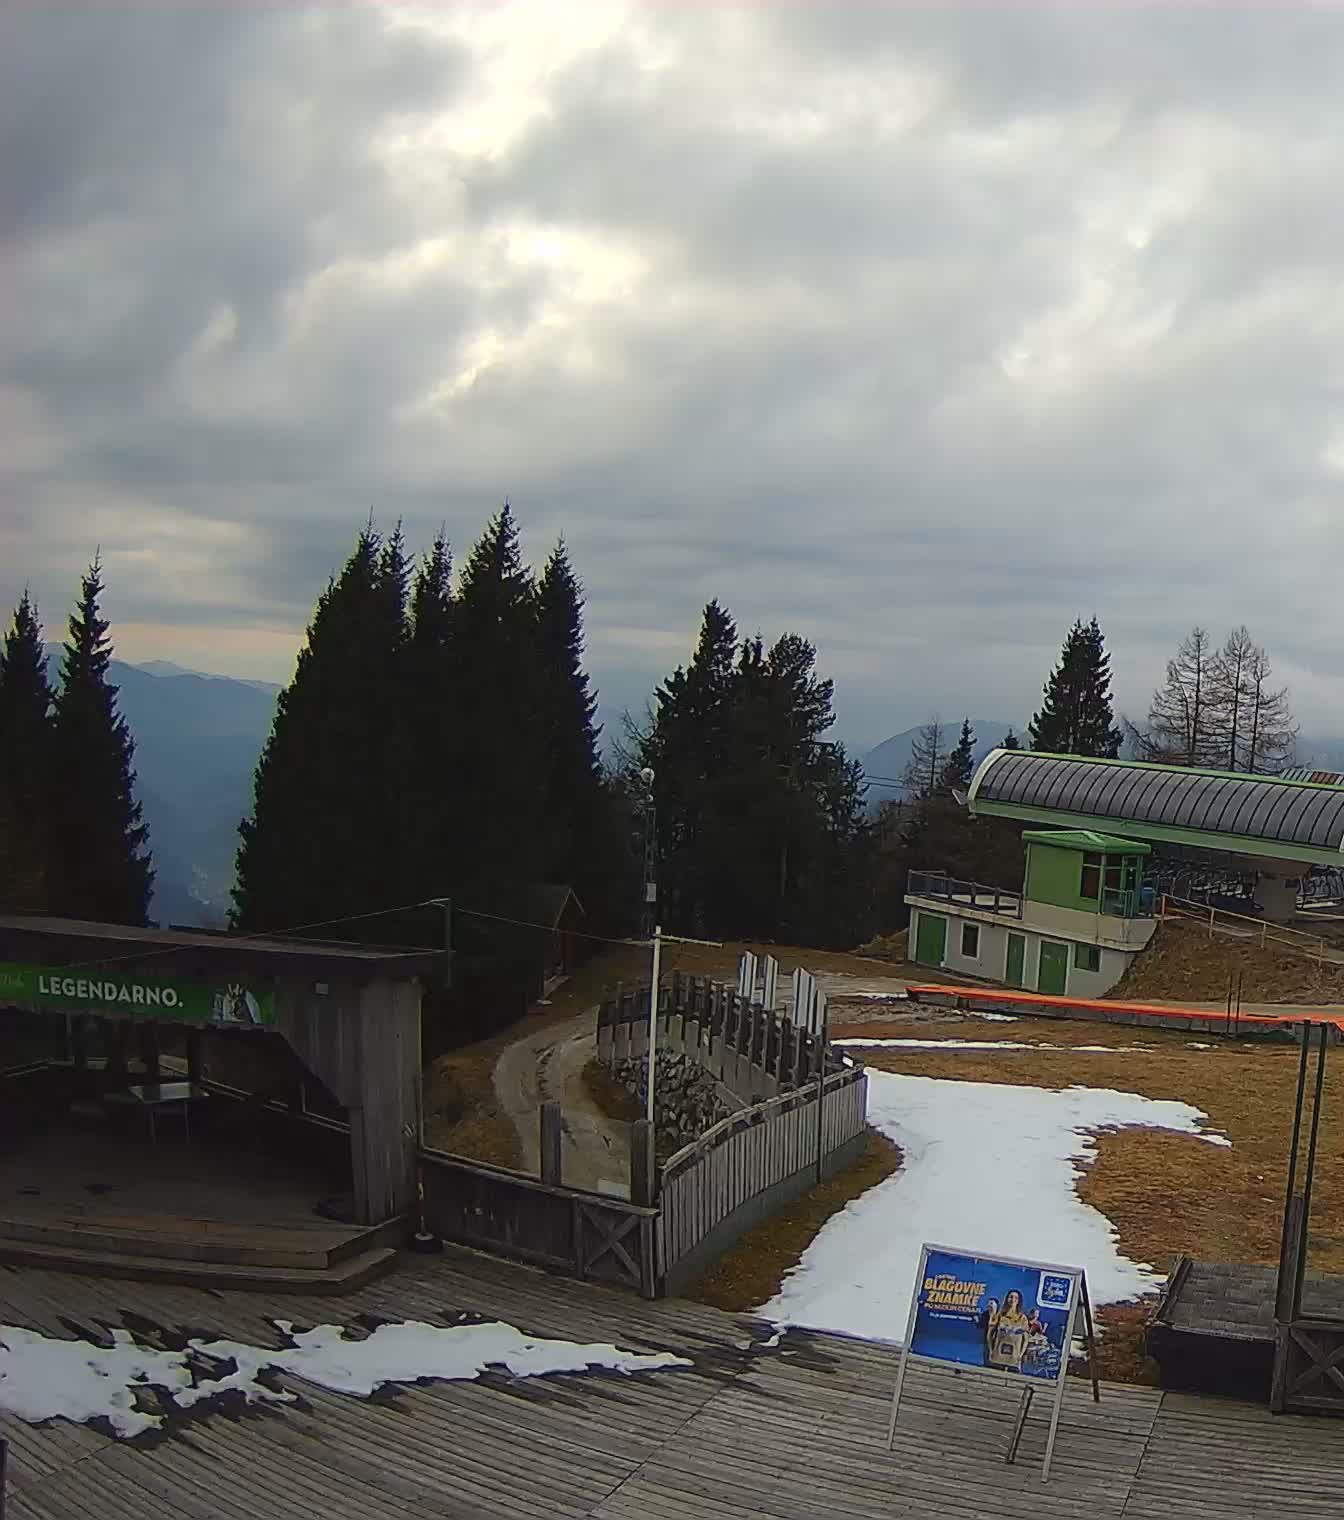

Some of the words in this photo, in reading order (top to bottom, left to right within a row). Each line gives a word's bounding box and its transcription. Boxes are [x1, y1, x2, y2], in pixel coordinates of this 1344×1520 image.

[38, 975, 184, 1008] LEGENDARNO.
[924, 1278, 987, 1296] BLAGOVNE
[927, 1290, 981, 1307] ZNAMKE
